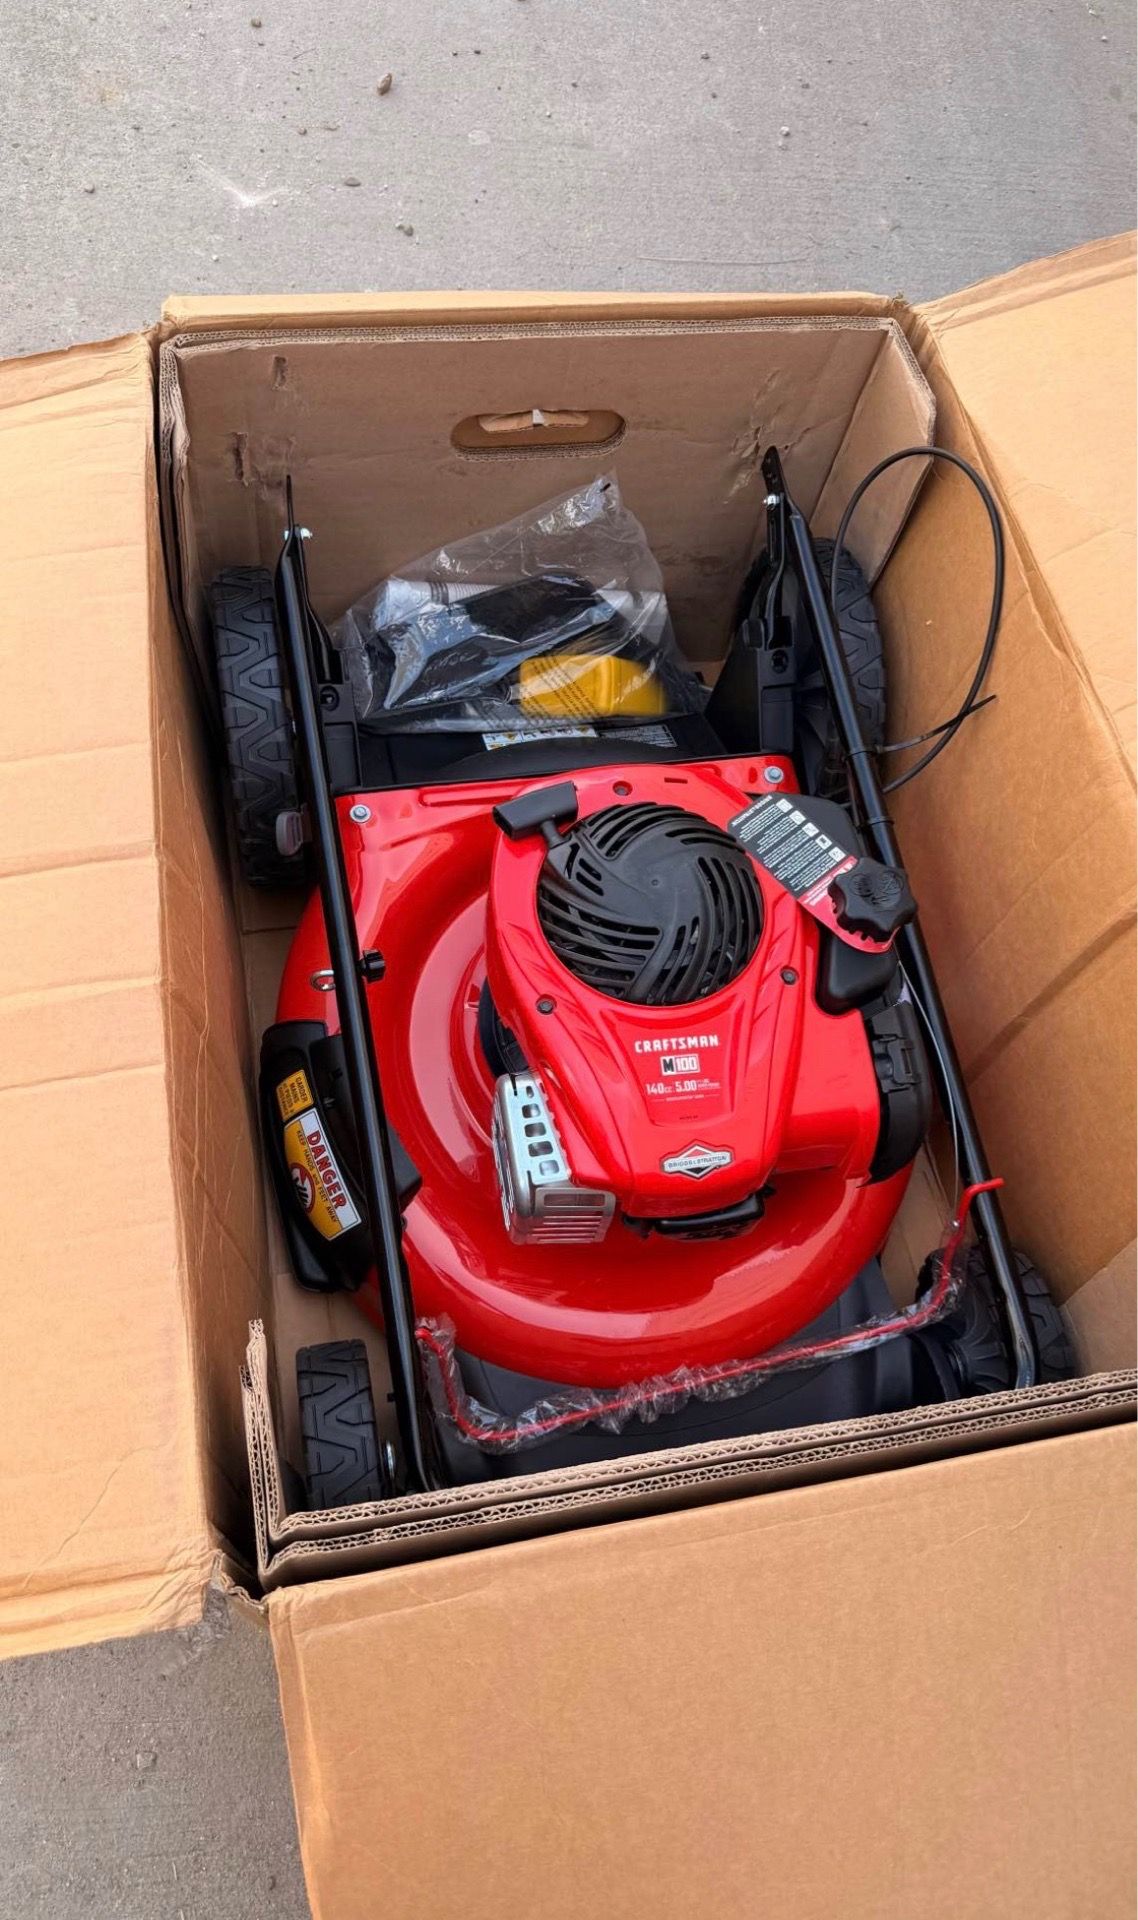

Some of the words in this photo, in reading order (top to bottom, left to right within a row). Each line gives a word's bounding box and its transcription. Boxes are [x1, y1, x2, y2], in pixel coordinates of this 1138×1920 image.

[634, 1035, 719, 1053] CRAFTSMAN
[662, 1055, 699, 1074] M100
[675, 1080, 697, 1093] 5.00
[297, 1130, 307, 1146] KEEP
[303, 1149, 316, 1171] HANDS
[319, 1186, 328, 1202] FEET
[326, 1205, 338, 1222] AWAY
[306, 1130, 347, 1209] DANGER
